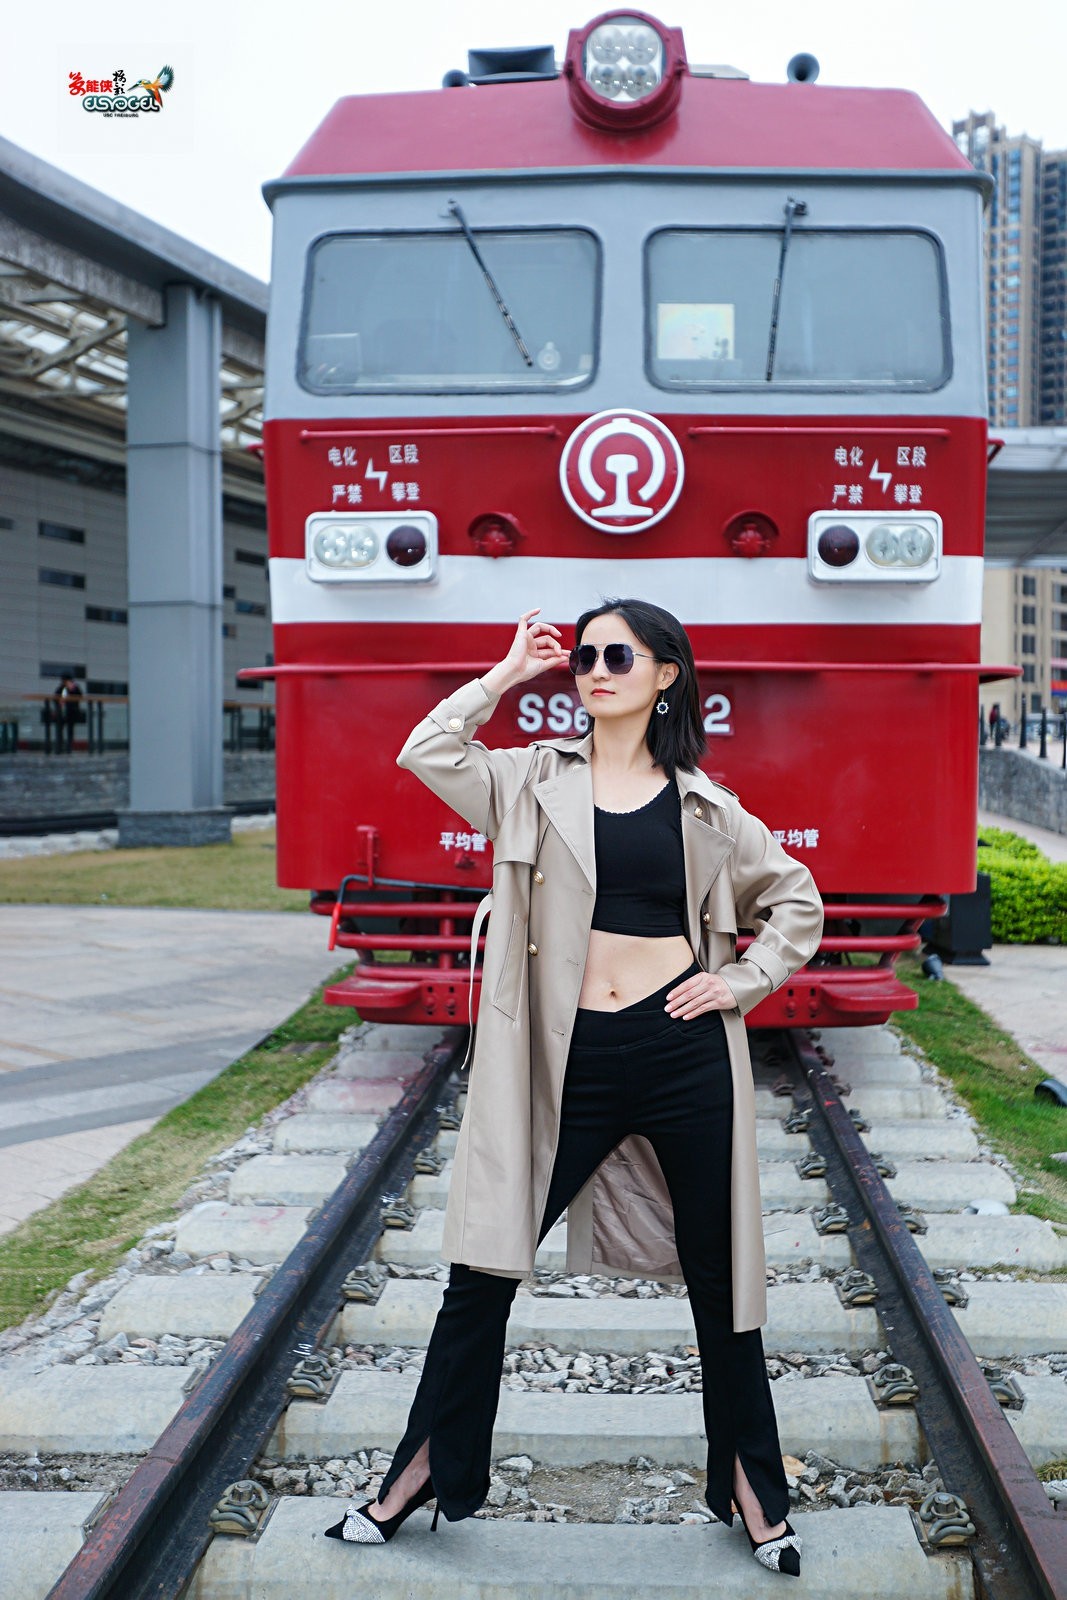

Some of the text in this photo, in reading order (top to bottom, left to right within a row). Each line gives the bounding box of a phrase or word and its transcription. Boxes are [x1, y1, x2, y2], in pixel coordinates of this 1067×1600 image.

[328, 444, 420, 467] 电化 区段
[834, 445, 927, 468] 电化 区段
[332, 483, 363, 505] 严禁
[831, 483, 864, 505] 严禁
[439, 831, 488, 852] 平均管
